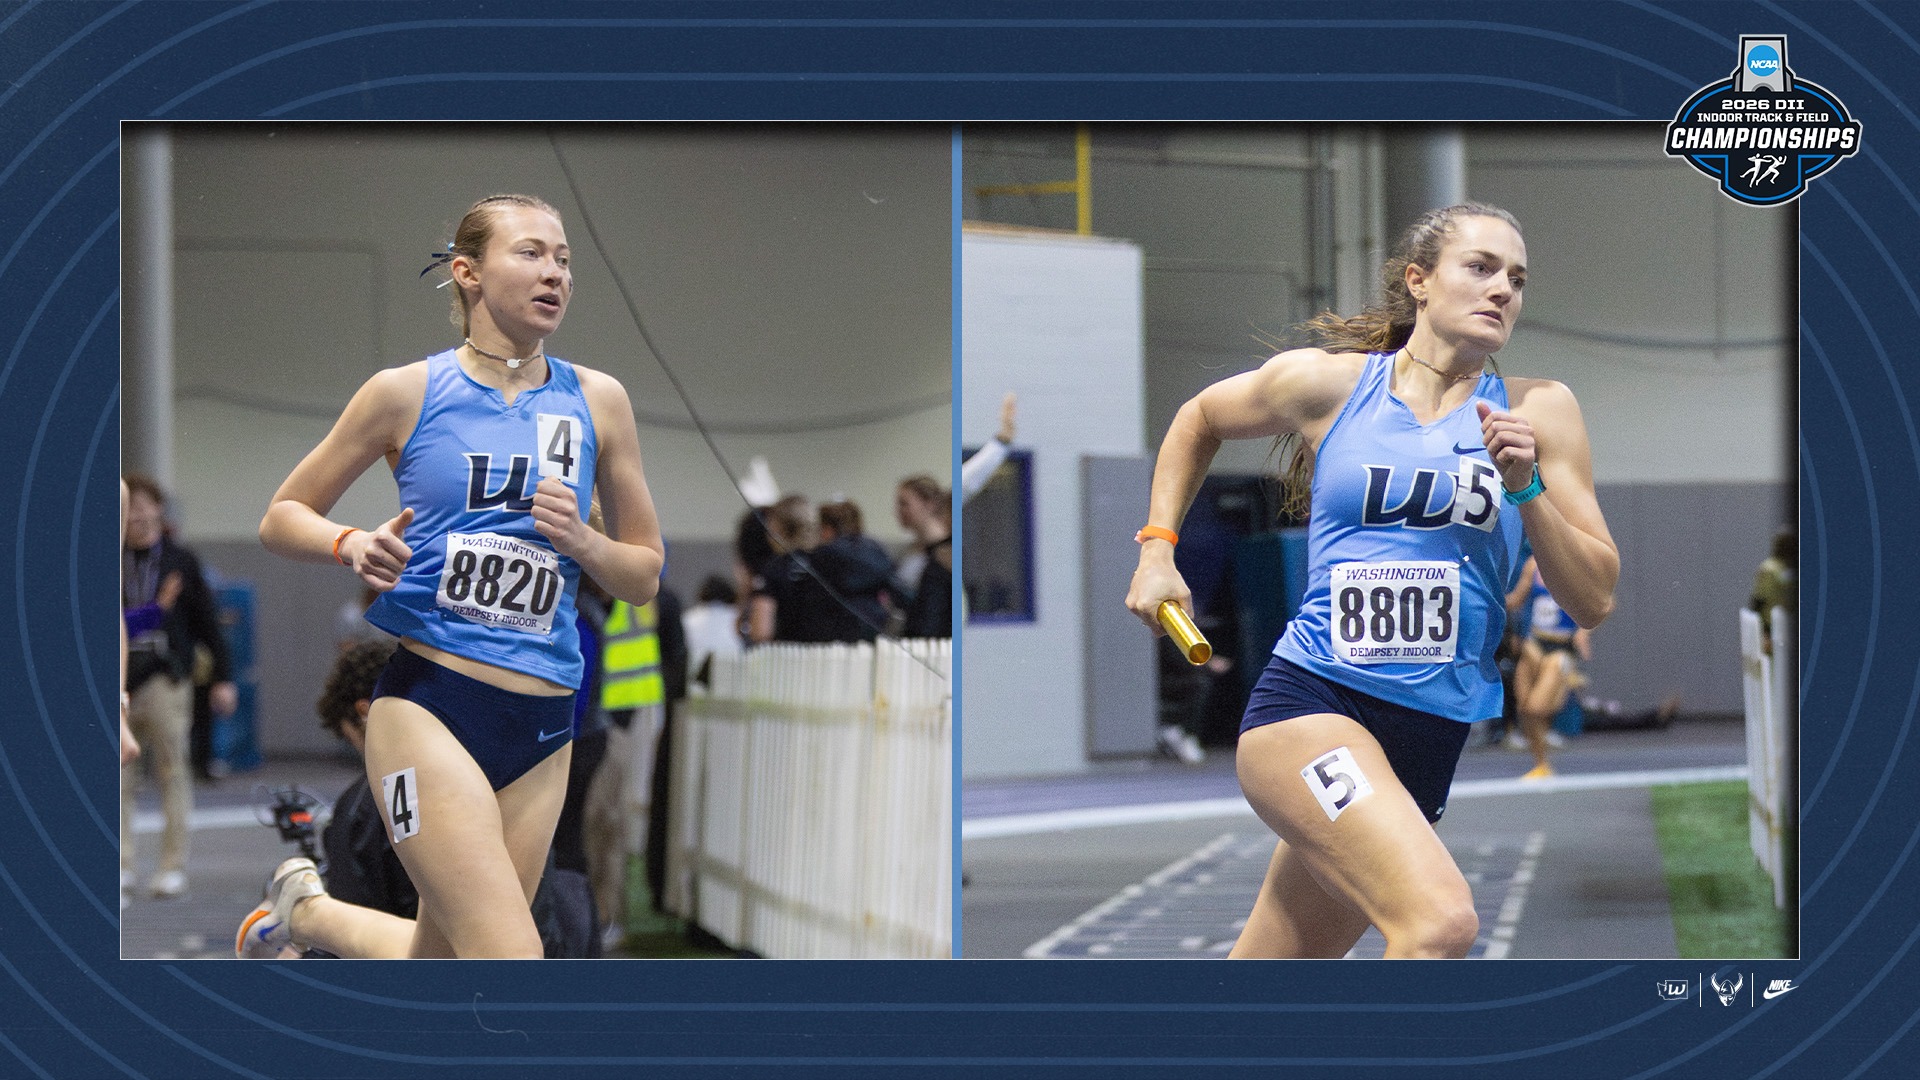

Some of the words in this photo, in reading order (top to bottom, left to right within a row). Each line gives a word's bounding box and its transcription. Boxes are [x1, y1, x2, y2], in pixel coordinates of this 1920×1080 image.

[546, 419, 574, 477] 4
[1464, 463, 1495, 526] 5
[462, 537, 548, 564] WASHINGTON
[1345, 567, 1447, 581] WASHINGTON
[446, 549, 559, 616] 8820
[452, 605, 500, 622] DEMPSEY
[501, 614, 538, 628] INDOOR
[1339, 586, 1453, 643] 8803
[1350, 647, 1400, 657] DEMPSEY
[1403, 646, 1442, 657] INDOOR
[392, 774, 412, 834] 4
[1313, 754, 1356, 810] 5
